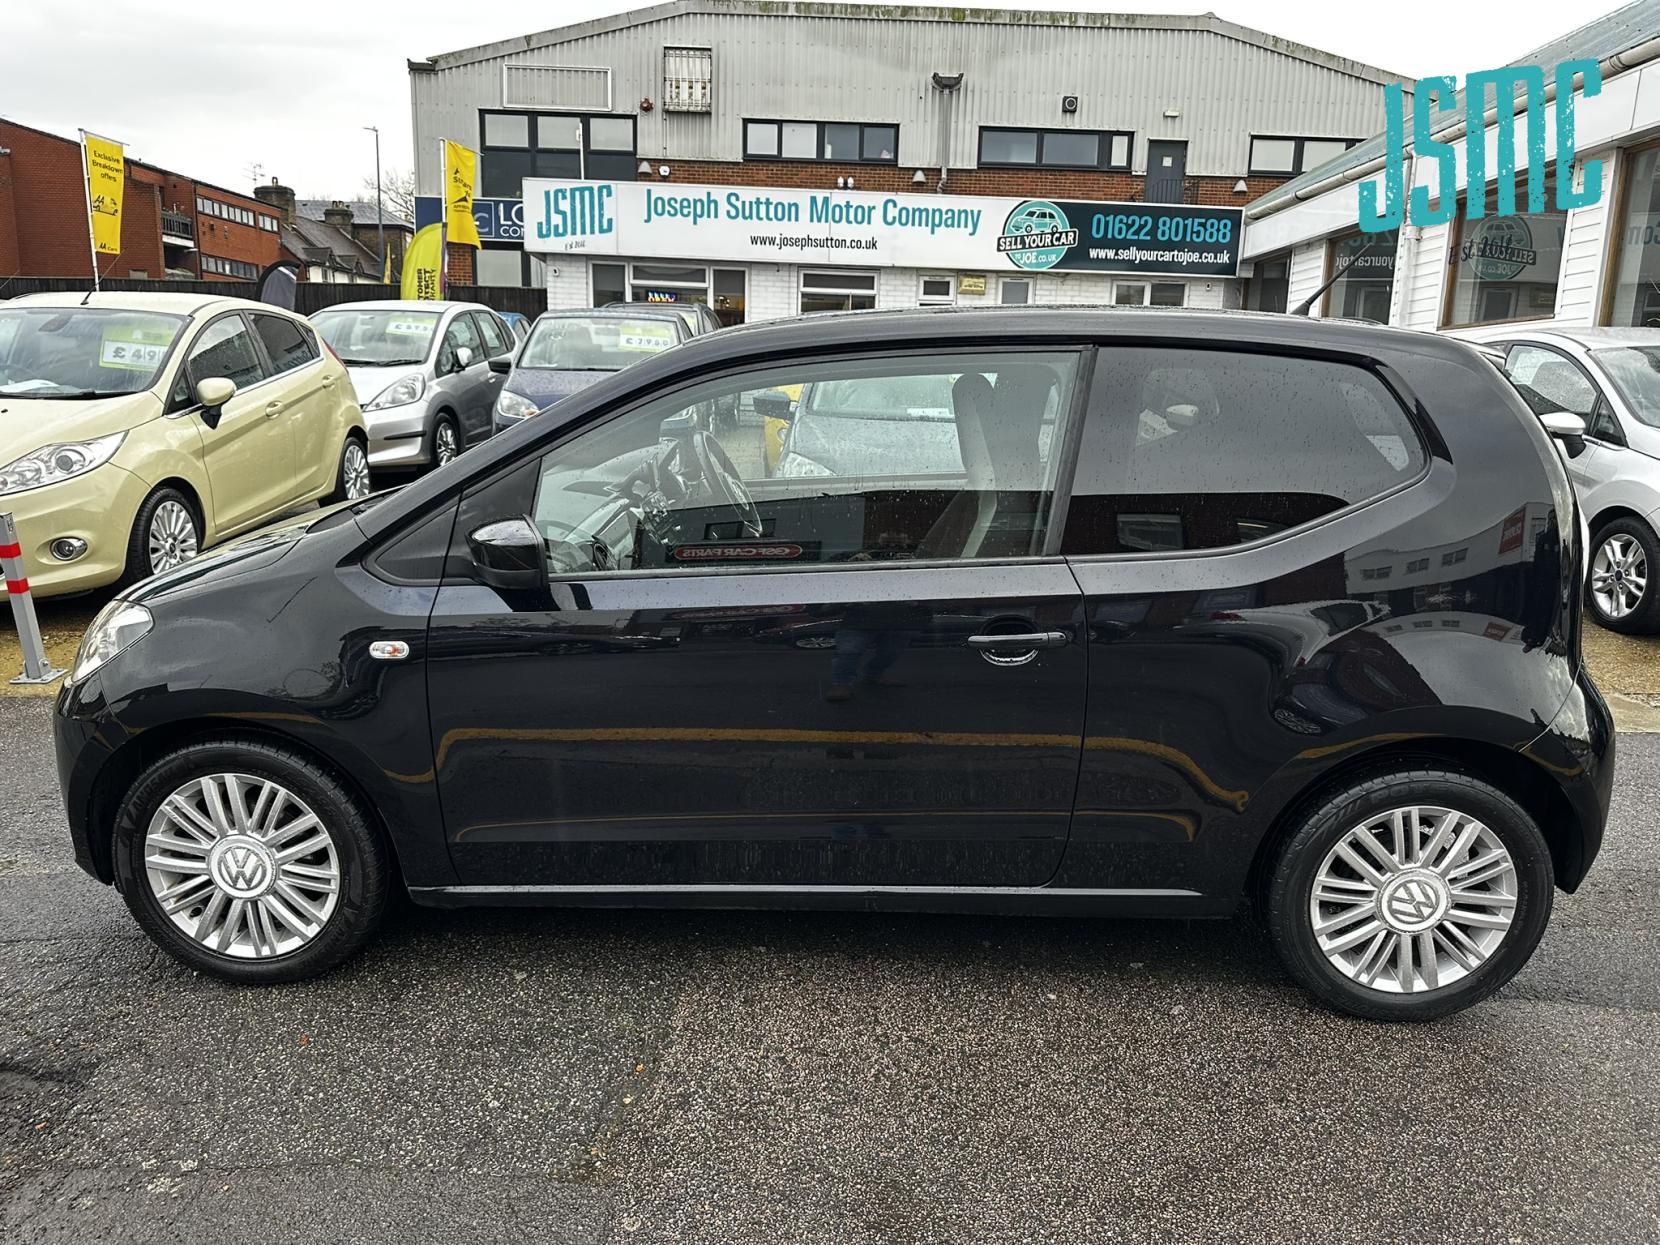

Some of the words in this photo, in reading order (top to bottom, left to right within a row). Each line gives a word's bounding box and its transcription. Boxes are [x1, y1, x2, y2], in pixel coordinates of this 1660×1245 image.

[93, 150, 120, 164] Exclusive
[537, 184, 613, 239] JSMC
[644, 188, 719, 225] Joseph
[726, 192, 799, 222] Sutton
[809, 195, 876, 226] Motor
[882, 198, 981, 236] Company
[1091, 213, 1152, 241] 01622
[1157, 216, 1232, 244] 801588
[750, 233, 878, 251] www.josephsutton.co.uk
[999, 236, 1023, 251] SELL
[1023, 233, 1052, 248] YOUR
[1052, 231, 1075, 246] CAR
[1089, 246, 1231, 266] www.sellyourcartojoe.co.uk
